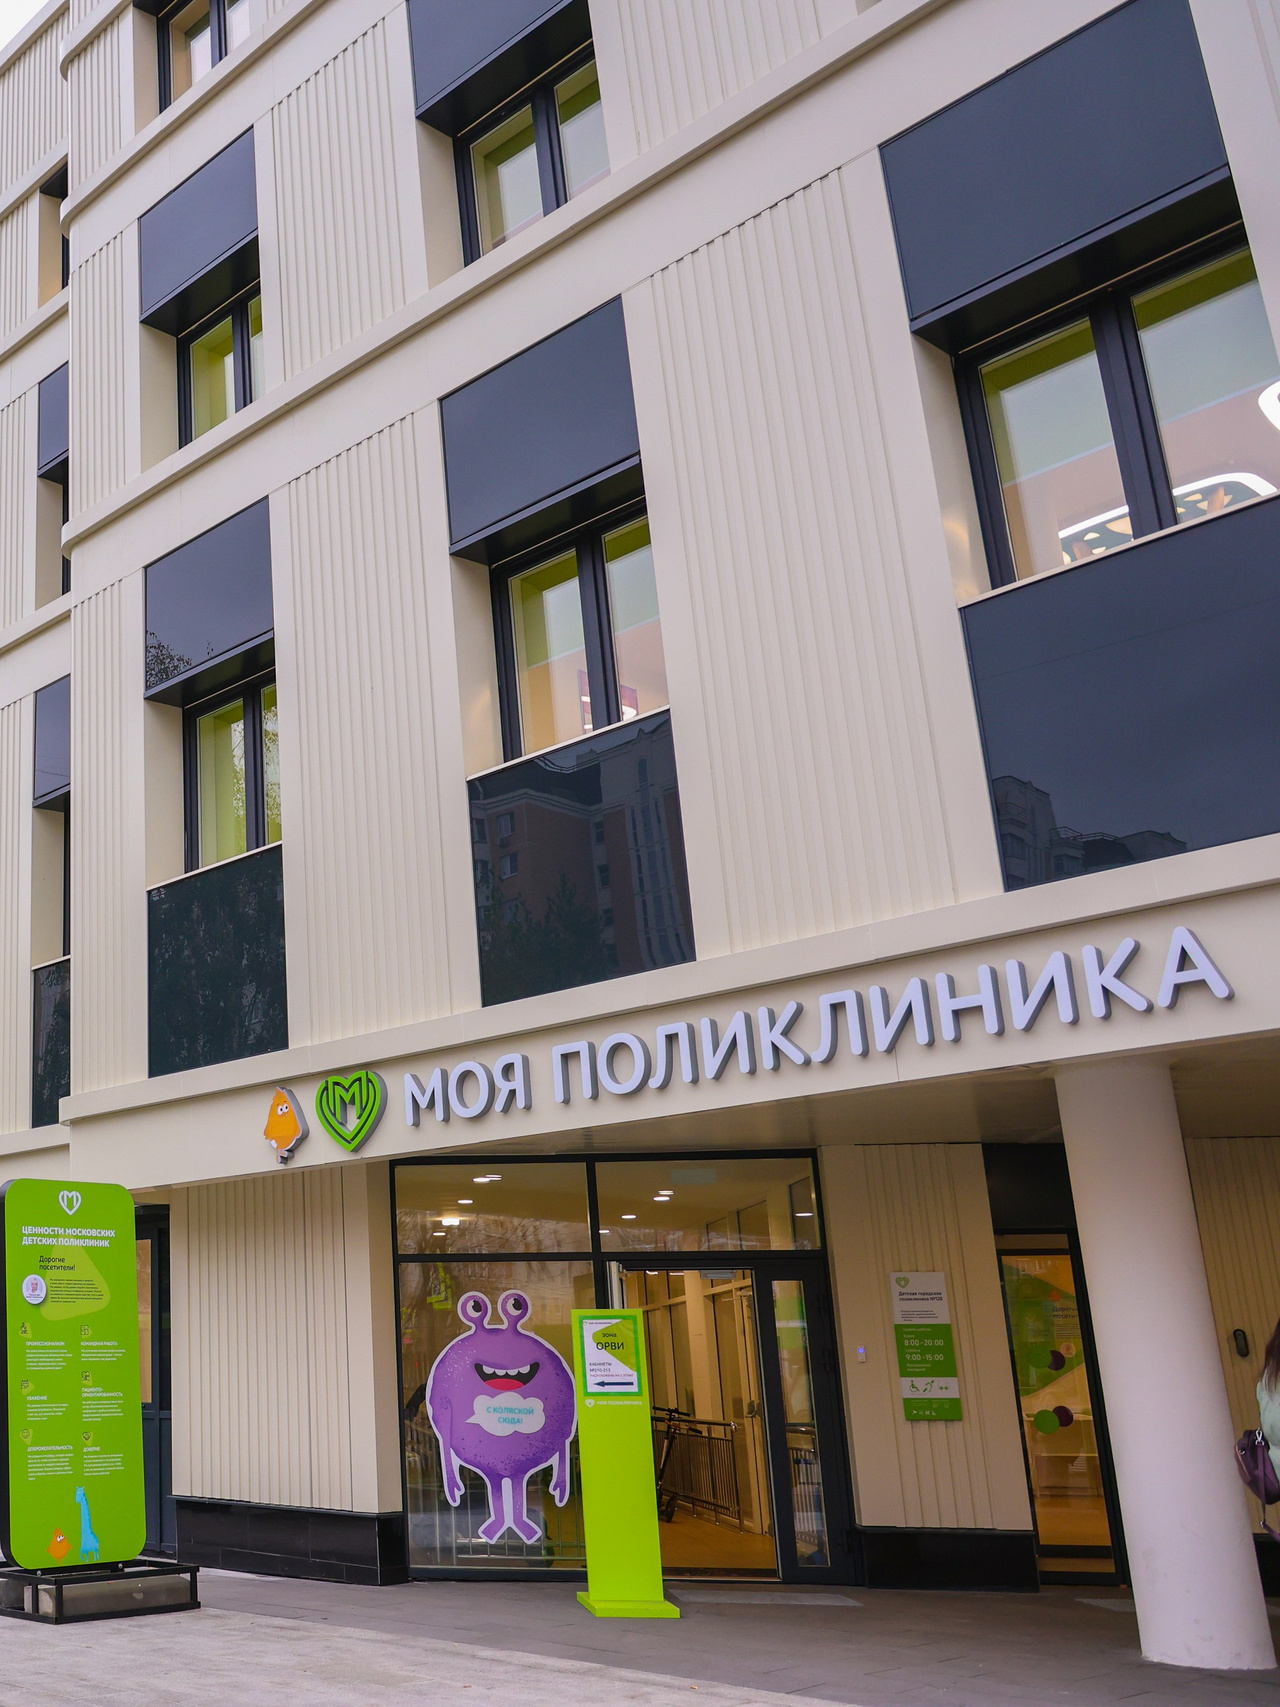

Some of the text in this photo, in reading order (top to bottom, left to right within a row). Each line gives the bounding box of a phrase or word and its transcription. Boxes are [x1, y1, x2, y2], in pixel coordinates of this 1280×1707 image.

[404, 926, 1234, 1127] МОЯ ПОЛИКЛИНИКА
[22, 1226, 115, 1237] ЦЕННОСТИ МОСКОВСКИХ
[22, 1236, 110, 1247] ДЕТСКИХ ПОЛИКЛИНИК
[39, 1255, 65, 1263] Дорогие
[596, 1341, 624, 1350] ОРВИ
[493, 1407, 534, 1415] КОЛЯСКОЙ
[497, 1416, 523, 1425] СЮДА!
